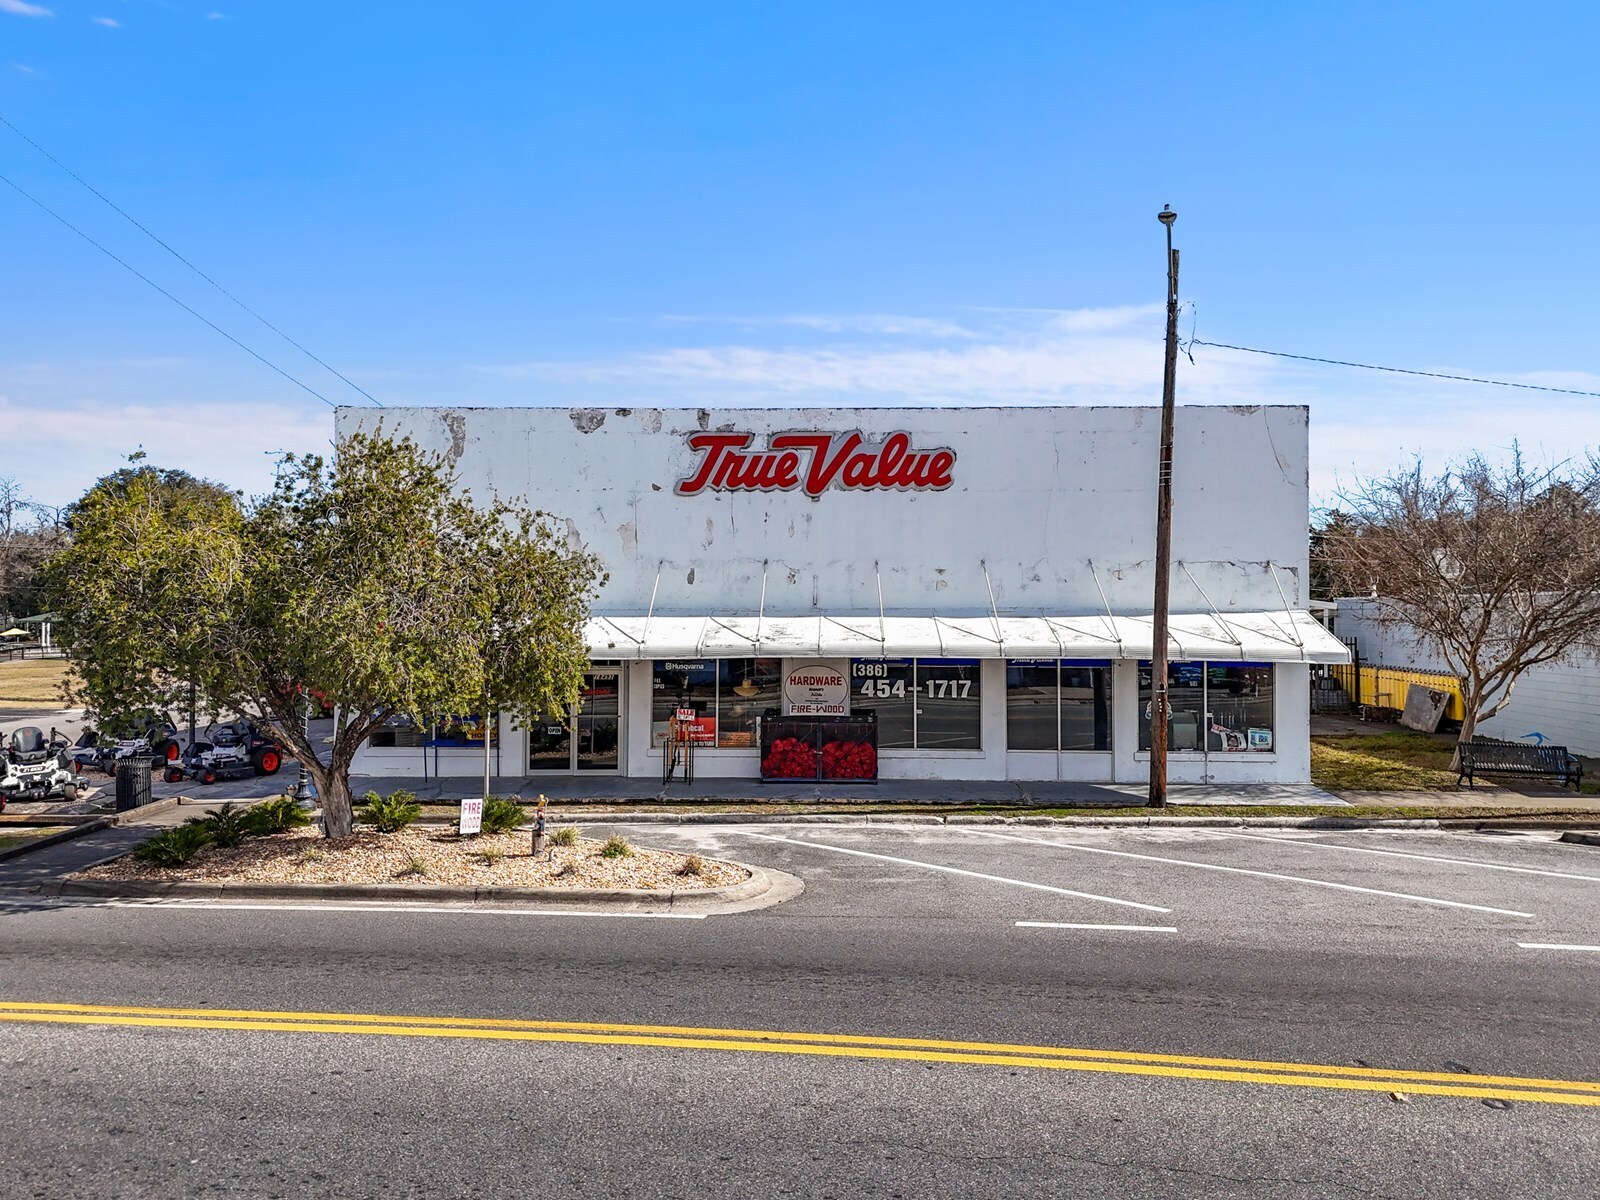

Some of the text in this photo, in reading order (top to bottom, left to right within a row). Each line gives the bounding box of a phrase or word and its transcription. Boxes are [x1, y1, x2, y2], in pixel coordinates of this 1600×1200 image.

[677, 430, 957, 496] True Value
[672, 663, 705, 671] Husqvarna
[852, 663, 888, 677] (386)
[789, 675, 843, 686] HARDWARE
[790, 704, 845, 714] FIRE-WOOD
[682, 724, 705, 732] Bbcat
[462, 802, 482, 815] FIRE
[461, 816, 480, 829] WOOD
